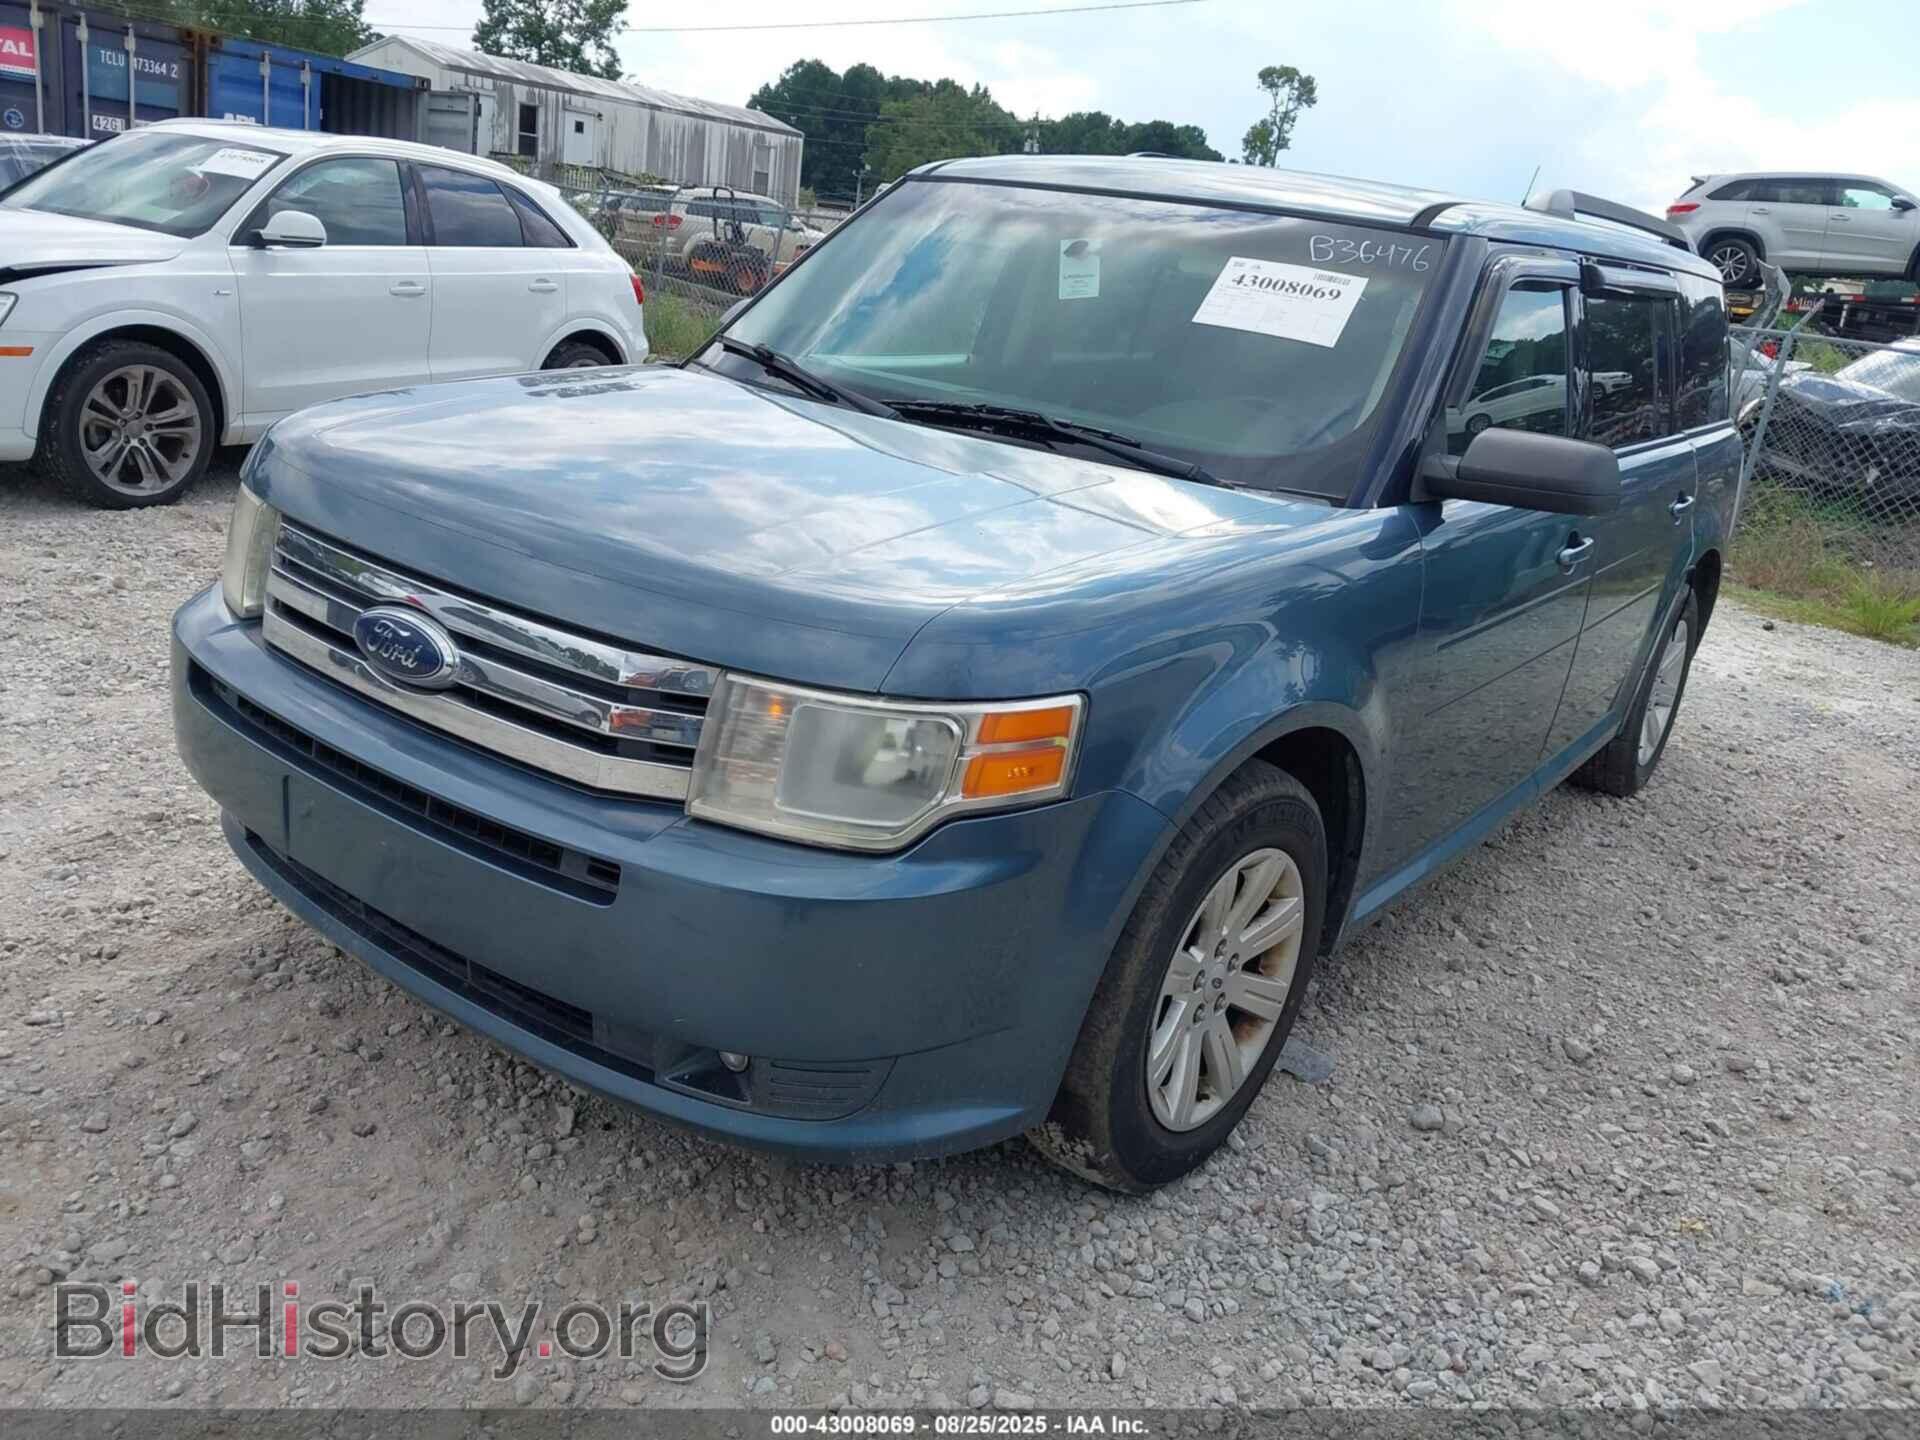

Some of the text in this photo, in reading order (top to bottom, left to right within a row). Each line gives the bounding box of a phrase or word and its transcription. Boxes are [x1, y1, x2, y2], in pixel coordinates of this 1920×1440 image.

[99, 49, 126, 67] TCLU
[170, 64, 178, 79] 2
[1308, 234, 1431, 272] B36476
[1231, 272, 1342, 302] 43008069
[366, 619, 424, 669] Ford
